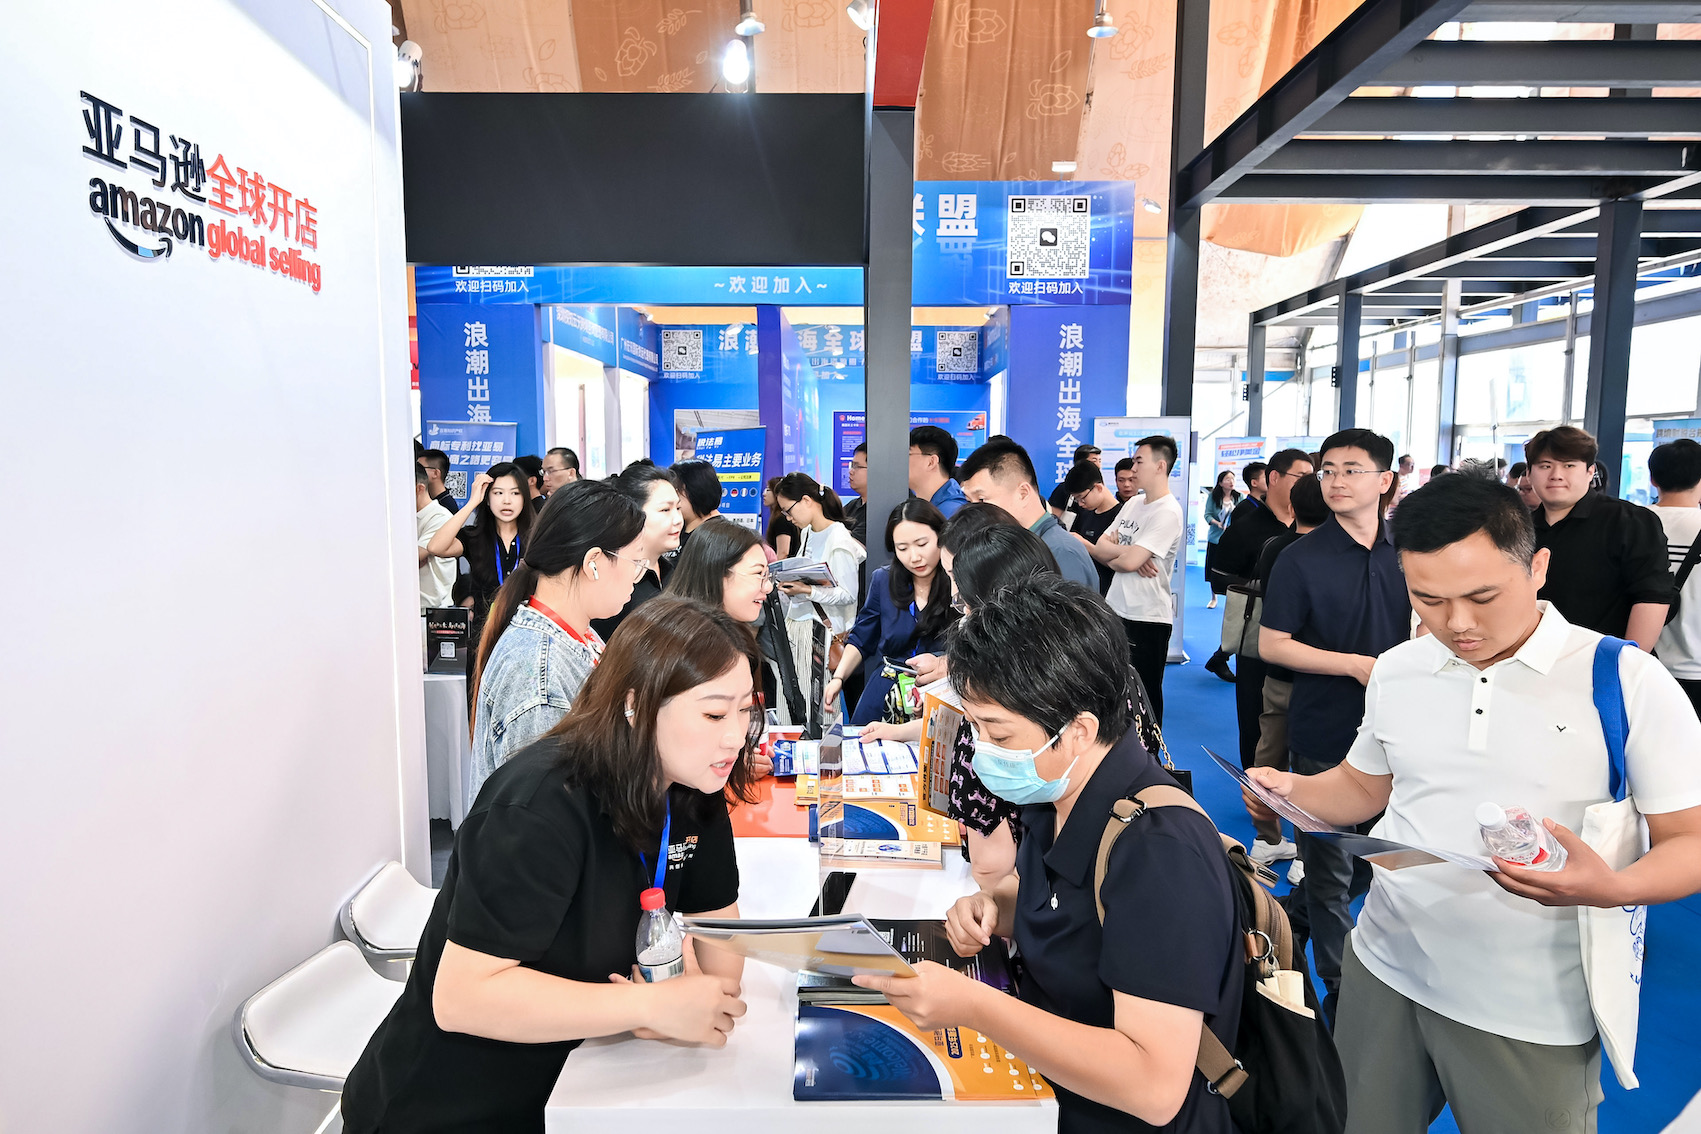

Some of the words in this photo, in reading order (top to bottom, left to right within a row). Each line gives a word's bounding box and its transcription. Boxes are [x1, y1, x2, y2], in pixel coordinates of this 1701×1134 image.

[80, 90, 318, 249] 亚马逊全球开店
[89, 177, 205, 247] amazon
[206, 219, 266, 268] global
[269, 246, 321, 292] selling
[455, 280, 529, 293] 欢迎扫码加入
[1008, 281, 1083, 295] 欢迎扫码加入
[463, 321, 492, 422] 浪潮出海
